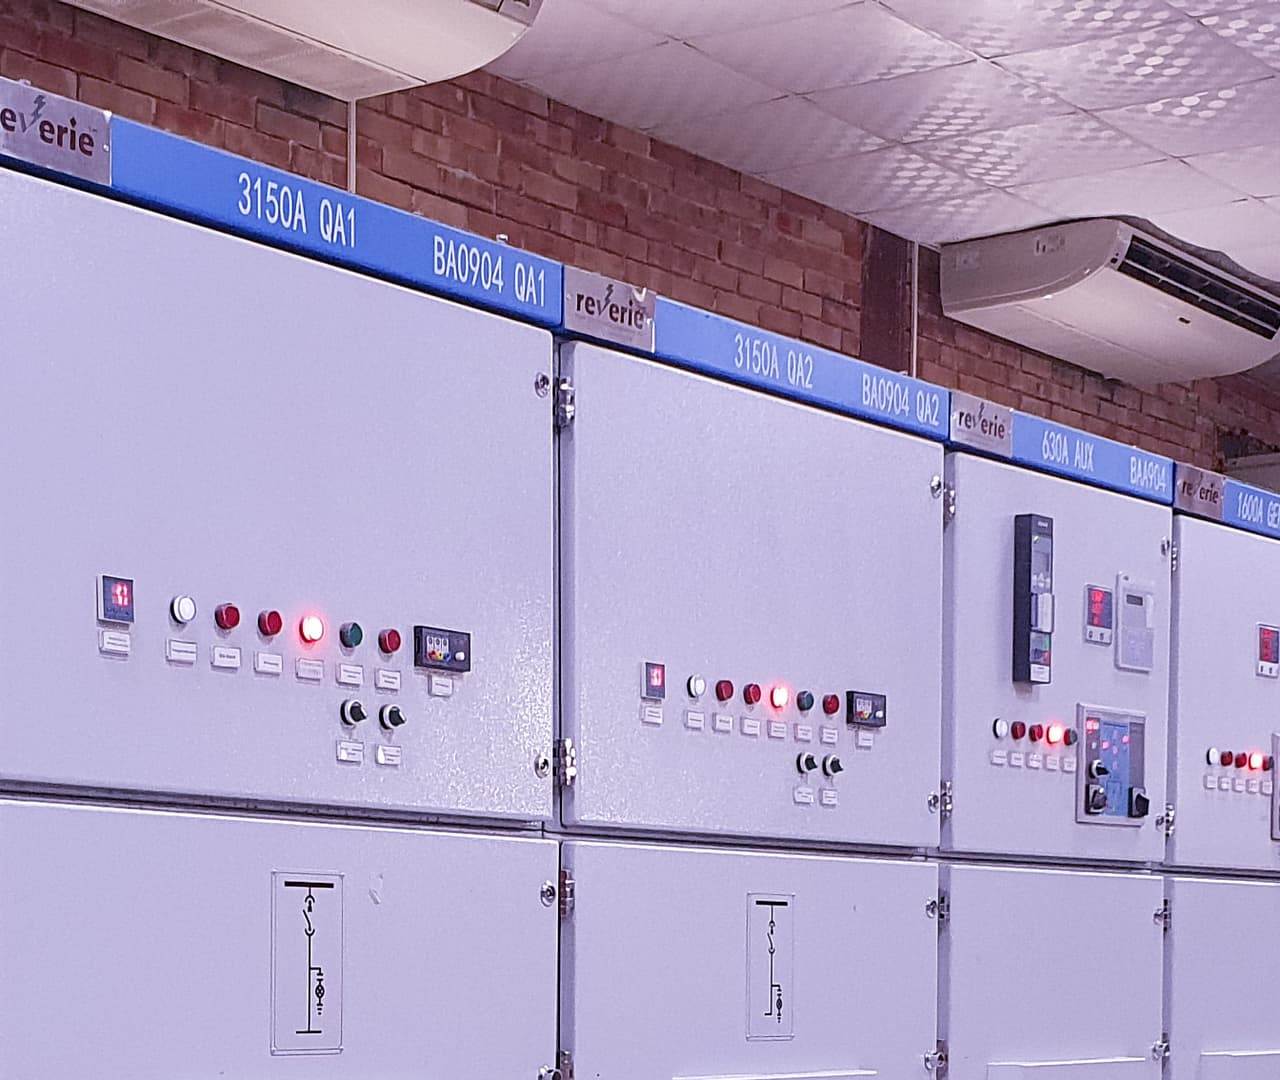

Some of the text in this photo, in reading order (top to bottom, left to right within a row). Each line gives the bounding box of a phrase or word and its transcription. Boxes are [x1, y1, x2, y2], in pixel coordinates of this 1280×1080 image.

[238, 172, 356, 248] 3150A QA1
[433, 235, 546, 307] BA0904 QA1
[576, 284, 645, 330] reverie
[734, 333, 814, 389] 3150A QA2
[862, 373, 940, 426] BA0904 QA2
[958, 402, 1006, 439] reverie
[1042, 430, 1095, 472] 630A AUX
[1238, 492, 1264, 525] 1600A
